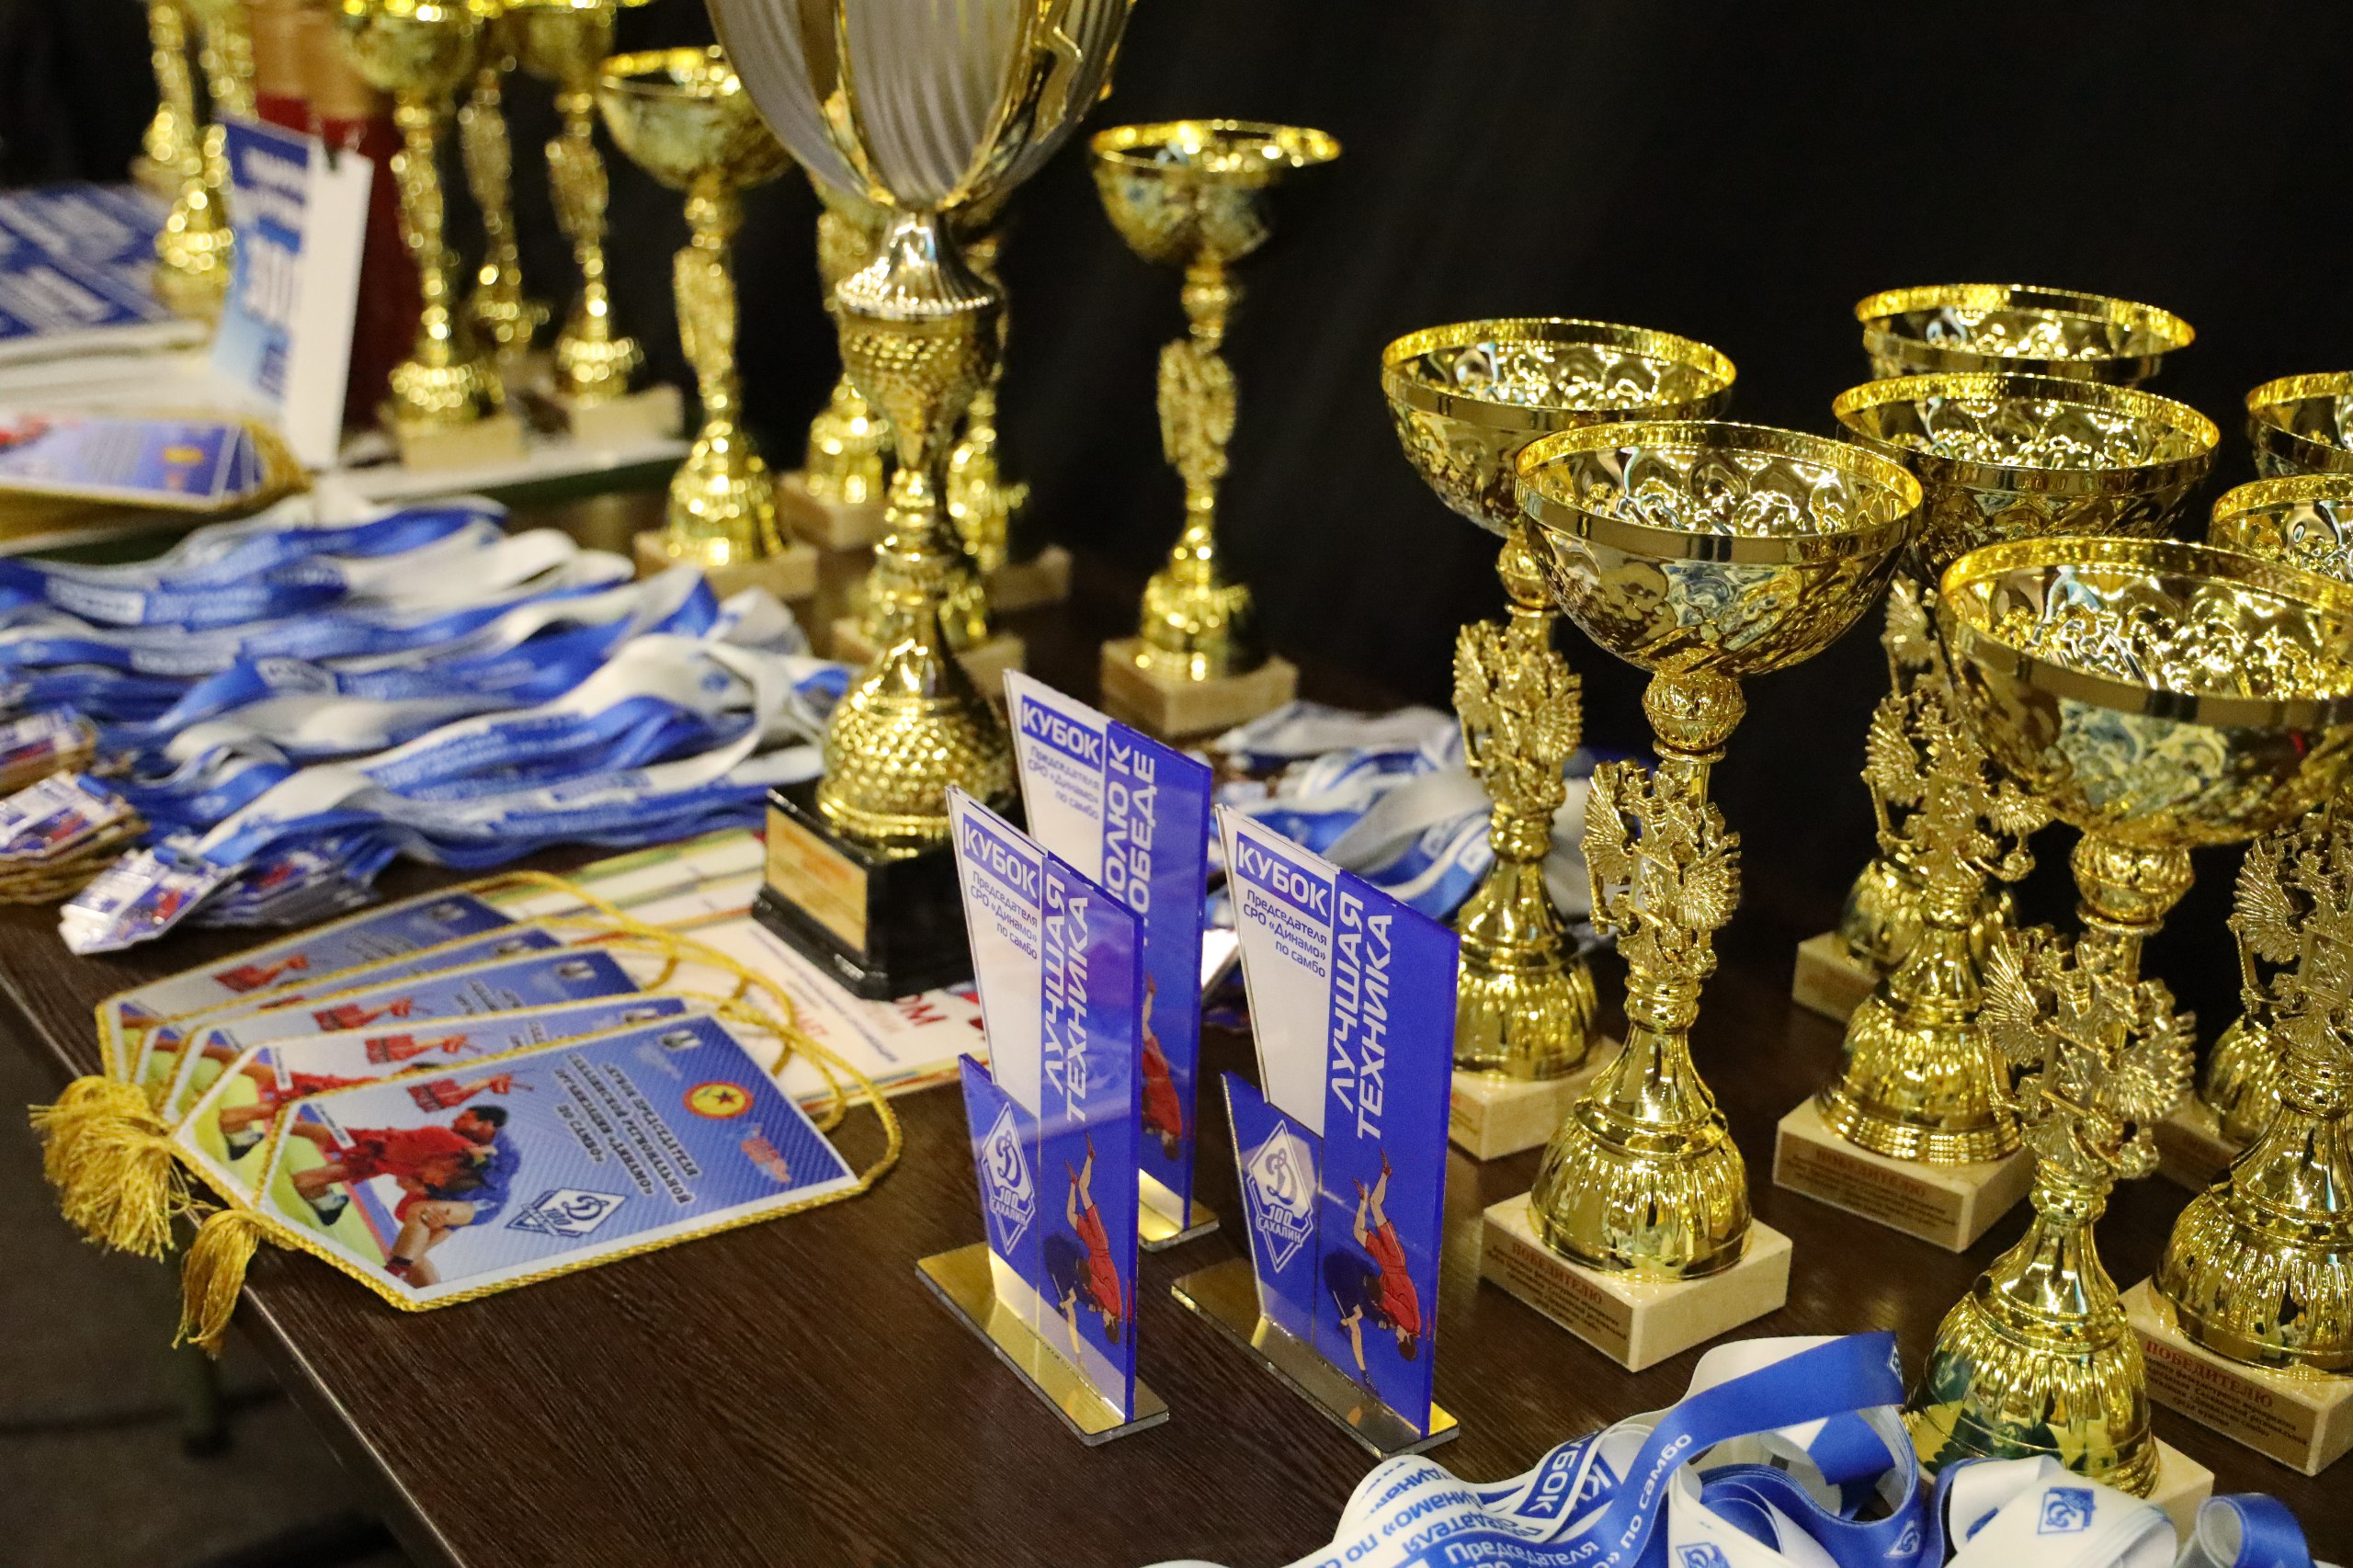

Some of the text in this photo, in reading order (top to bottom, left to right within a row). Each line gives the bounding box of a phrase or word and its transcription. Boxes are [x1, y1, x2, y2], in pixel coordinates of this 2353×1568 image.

[1023, 702, 1100, 765] КУБОК
[1108, 737, 1131, 776] К
[1029, 759, 1048, 778] СРО
[1030, 745, 1100, 790] Председателя
[1055, 790, 1098, 820] по самбо
[965, 824, 1038, 900] КУБОК
[1129, 750, 1157, 946] ОБЕДЕ
[972, 870, 1038, 928] Председателя
[1238, 842, 1328, 917] КУБОК
[971, 887, 1037, 943] СРО «Динамо»
[997, 923, 1038, 960] по самбо
[1244, 903, 1326, 960] СРО «Динамо»
[1247, 889, 1327, 946] Председателя
[1045, 873, 1065, 1096] ЛУЧШАЯ
[1276, 940, 1325, 978] по самбо
[1067, 897, 1088, 1122] ТЕХНИКА
[1332, 892, 1364, 1114] ЛУЧШАЯ
[1357, 915, 1392, 1140] ТЕХНИКА
[622, 1116, 690, 1203] РЕГИОНАЛЬНОЙ
[632, 1098, 699, 1176] ПРЕДСЕДАТЕЛЯ
[991, 1197, 1028, 1227] САХАЛИН
[998, 1187, 1019, 1209] 100
[1268, 1205, 1294, 1226] 100
[1257, 1216, 1302, 1244] САХАЛИН
[1512, 1242, 1603, 1305] ПОБЕДИТЕЛЮ
[2145, 1339, 2274, 1409] ПОБЕДИТЕЛЮ
[1620, 1434, 1692, 1549] по самбо
[1346, 1533, 1379, 1562] по
[1444, 1540, 1600, 1567] Председателя
